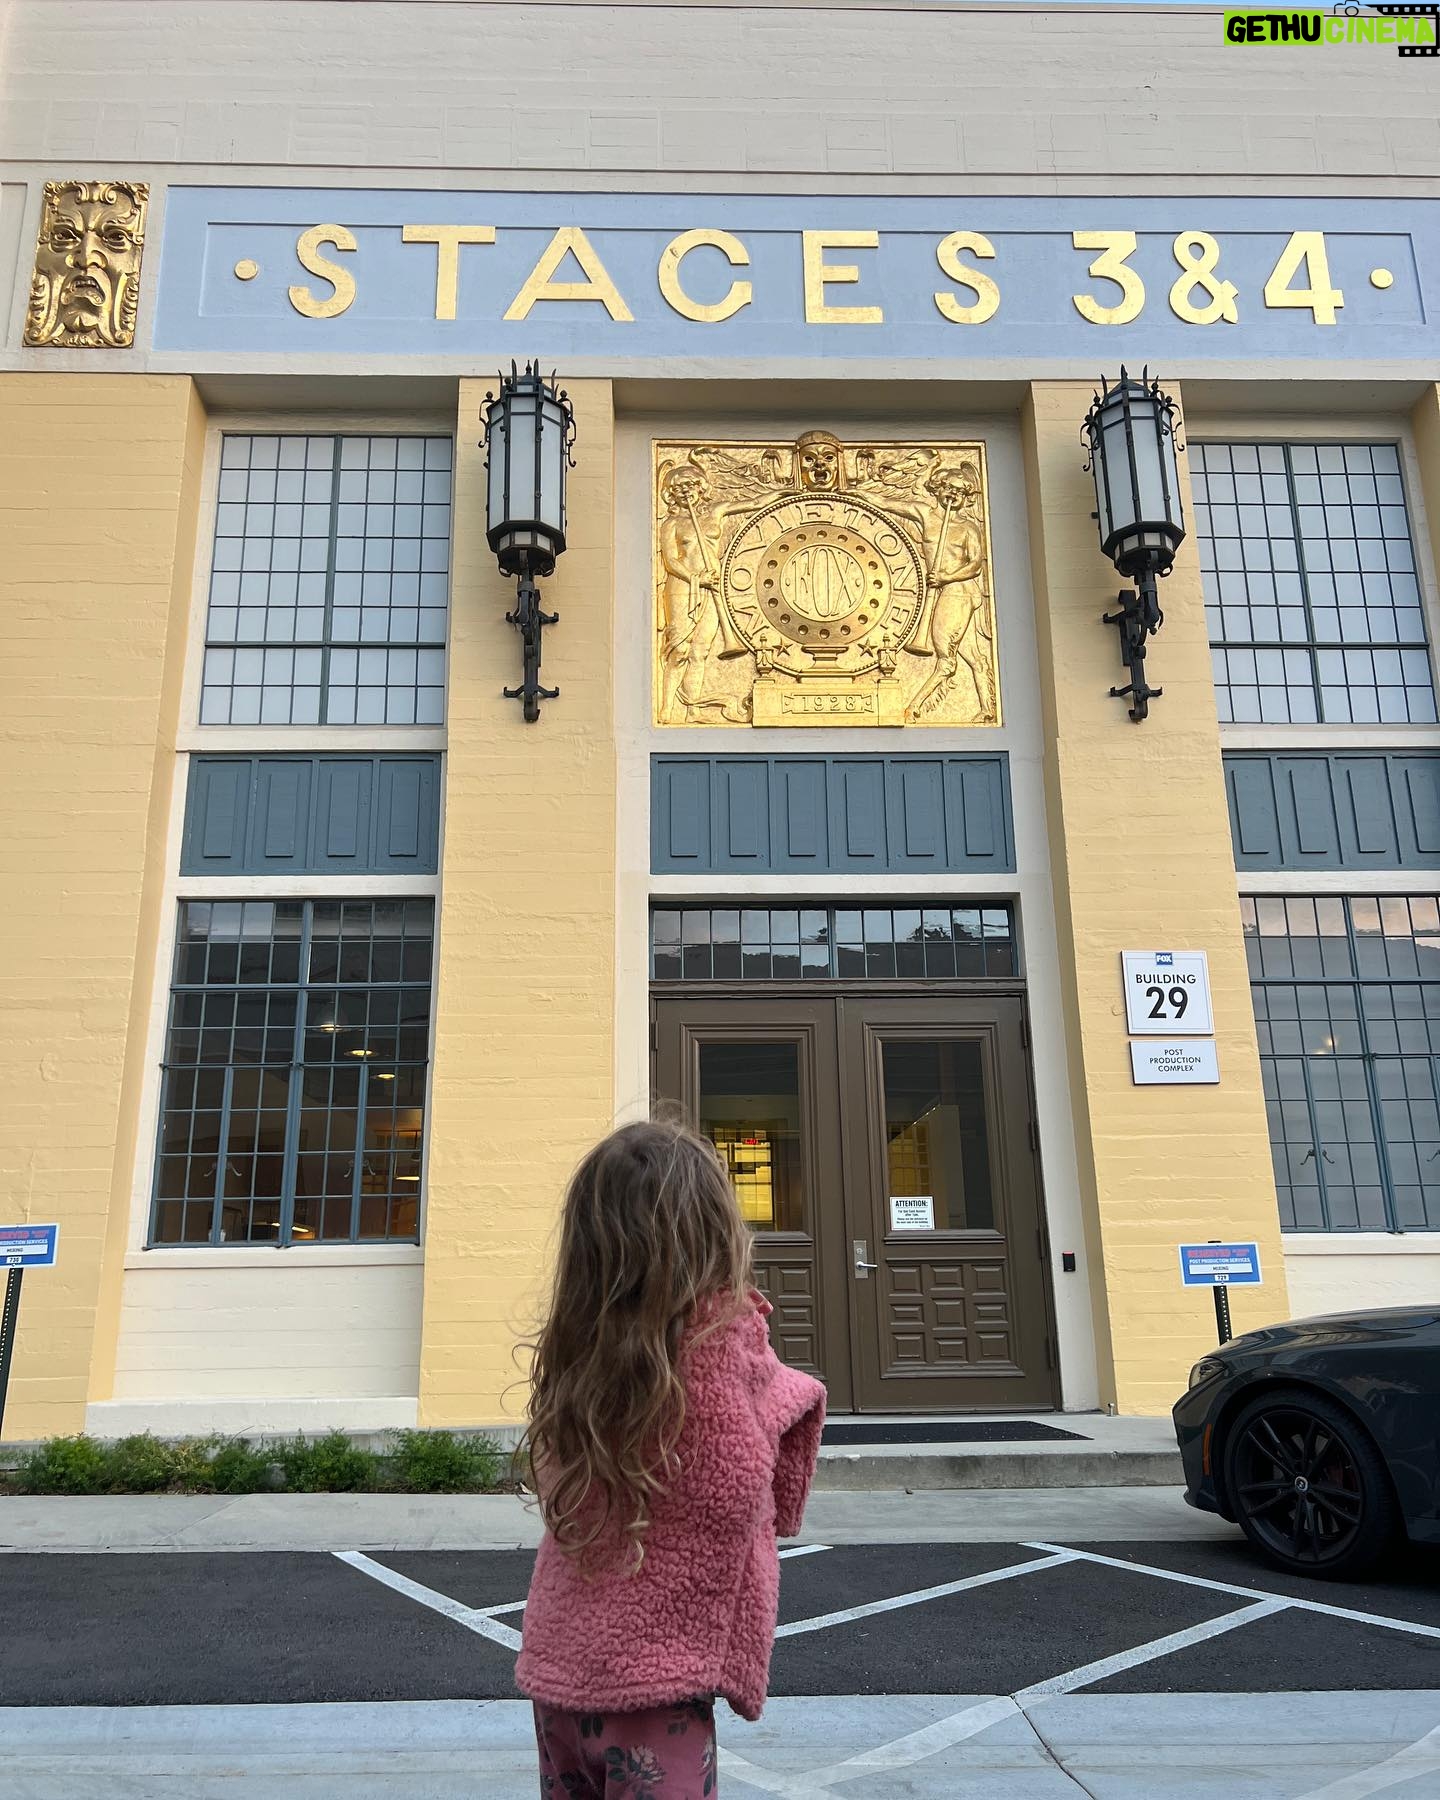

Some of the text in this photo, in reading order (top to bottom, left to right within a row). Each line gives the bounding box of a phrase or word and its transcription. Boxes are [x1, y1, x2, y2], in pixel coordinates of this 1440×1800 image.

[729, 502, 917, 639] MOVIETONE
[790, 547, 858, 618] FOX
[801, 696, 856, 712] 1928
[1156, 954, 1172, 963] FOX
[1135, 974, 1197, 984] BUILDING
[1145, 986, 1189, 1019] 29
[1149, 1056, 1201, 1064] PRODUCTION
